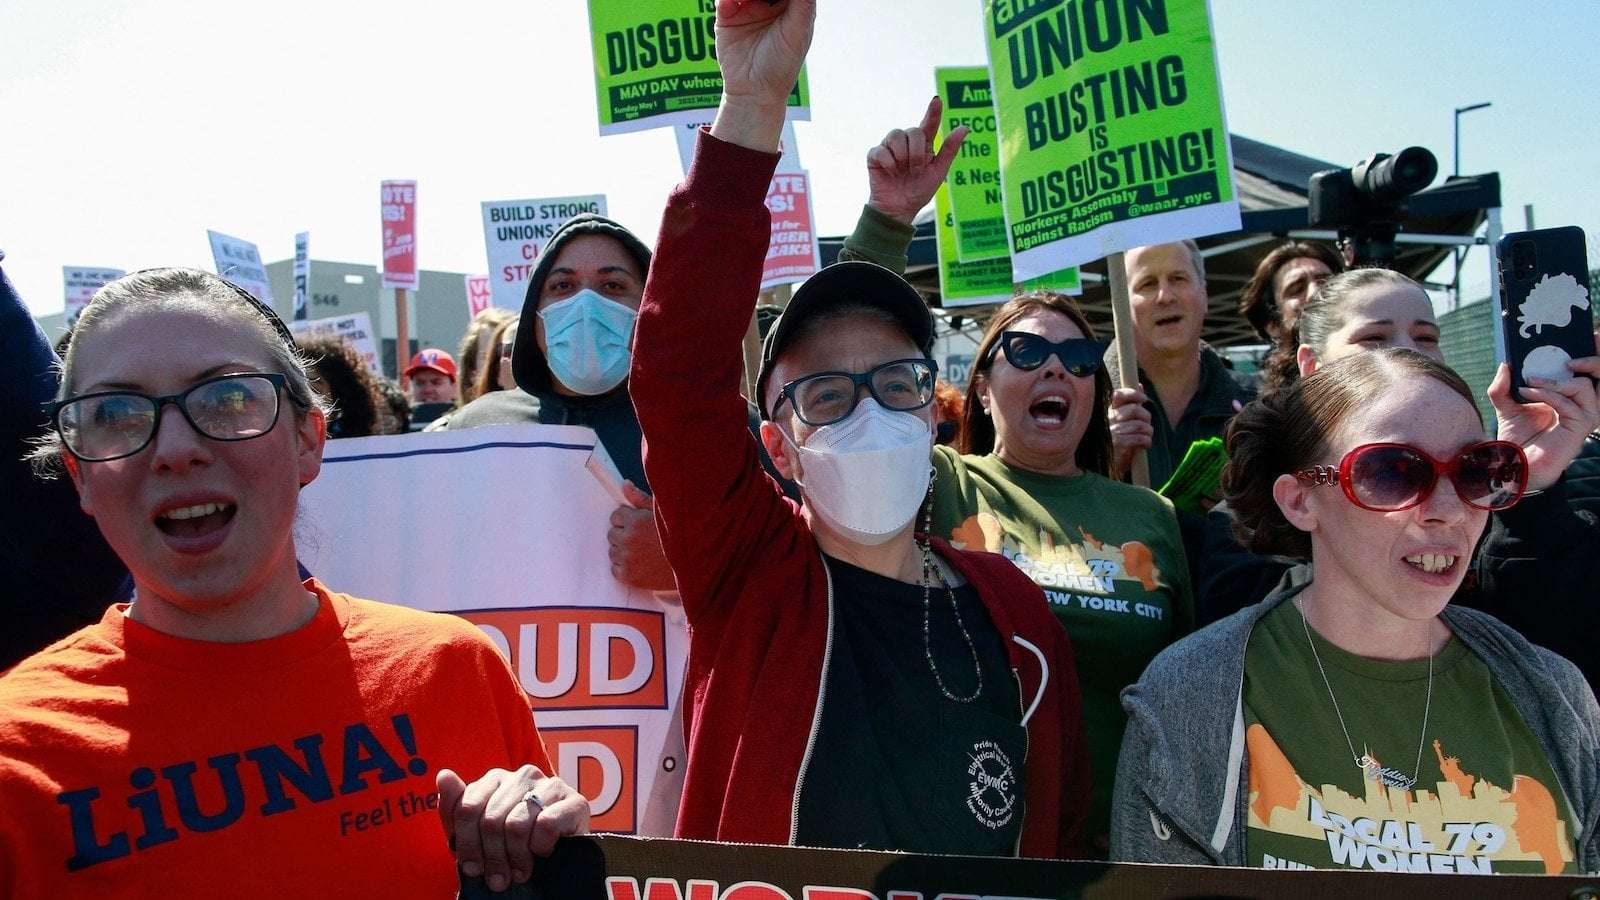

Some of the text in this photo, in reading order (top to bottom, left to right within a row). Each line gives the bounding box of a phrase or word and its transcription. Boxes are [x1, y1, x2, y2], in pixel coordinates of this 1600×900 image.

[1008, 0, 1169, 90] UNION
[620, 76, 723, 100] MAY DAY where
[614, 104, 638, 114] Sunday
[639, 101, 653, 111] May
[1025, 54, 1187, 151] BUSTING
[961, 140, 990, 158] The
[1089, 125, 1109, 151] IS
[955, 171, 966, 185] &
[1021, 128, 1216, 217] DISGUSTING!
[491, 202, 599, 222] BUILD STRONG
[1013, 211, 1067, 236] Workers
[1072, 189, 1138, 219] Assembly
[1016, 227, 1064, 250] Against
[1068, 211, 1114, 234] Racism
[1128, 190, 1212, 217] @waar_nyc
[497, 224, 553, 241] UNIONS
[1087, 559, 1120, 577] 79
[1077, 595, 1130, 613] YORK
[1134, 602, 1163, 620] CITY
[973, 741, 993, 751] Pride
[57, 713, 429, 873] LiUNA!
[978, 771, 1008, 791] EWMC
[340, 791, 438, 837] Feel the
[1309, 794, 1506, 855] LOCAL 79
[1324, 828, 1493, 875] WOMEN
